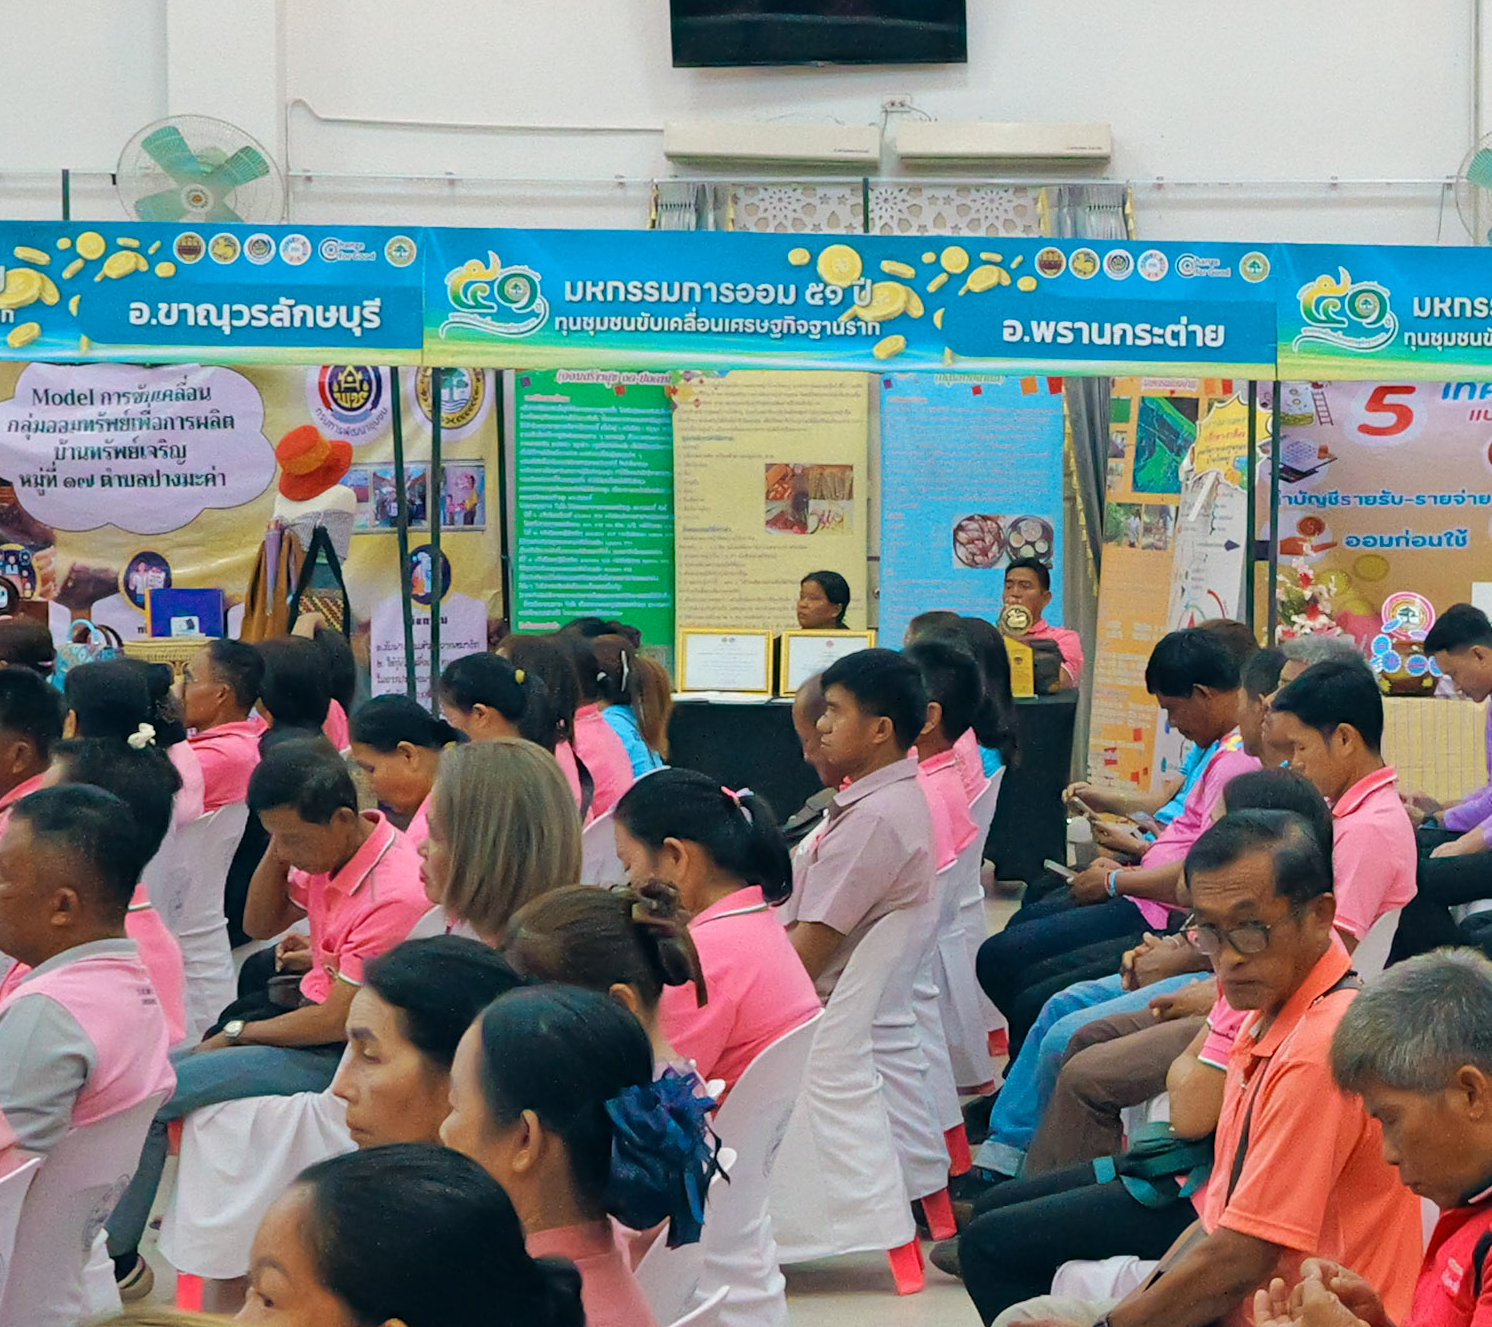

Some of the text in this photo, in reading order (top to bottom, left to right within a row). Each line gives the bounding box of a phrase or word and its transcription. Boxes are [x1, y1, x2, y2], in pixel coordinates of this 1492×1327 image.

[564, 276, 874, 308] มหกรรมการออม ๕๑ ปี
[128, 297, 382, 337] อ.ขาณุวรลักษบุรี
[1002, 315, 1225, 348] อ.พรานกระต่าย
[32, 388, 94, 407] Model
[1357, 385, 1416, 437] 5
[7, 404, 236, 441] กลุ่มออมทรัพย์เพื่อการผลิต
[54, 436, 188, 465] บ้านทรัพย์เจริญ
[1345, 528, 1468, 549] ออมก่อนใช้
